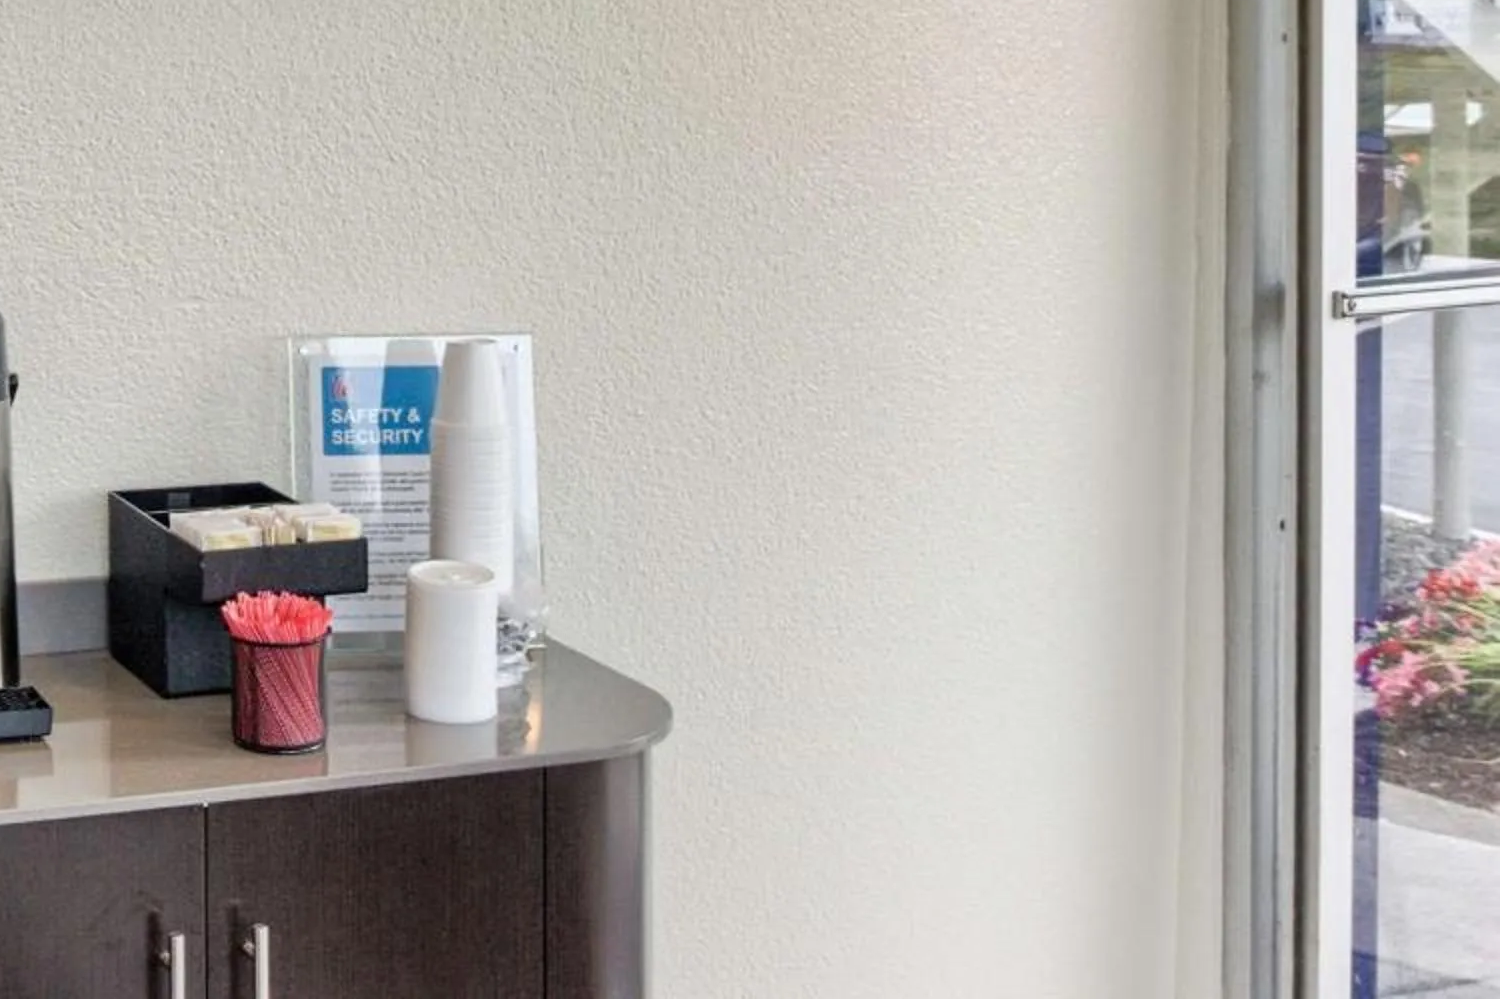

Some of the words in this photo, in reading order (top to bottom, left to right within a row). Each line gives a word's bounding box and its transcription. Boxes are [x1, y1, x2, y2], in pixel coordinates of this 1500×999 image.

[331, 408, 403, 424] SAFETY
[407, 407, 421, 424] &
[331, 428, 424, 445] SECURITY
